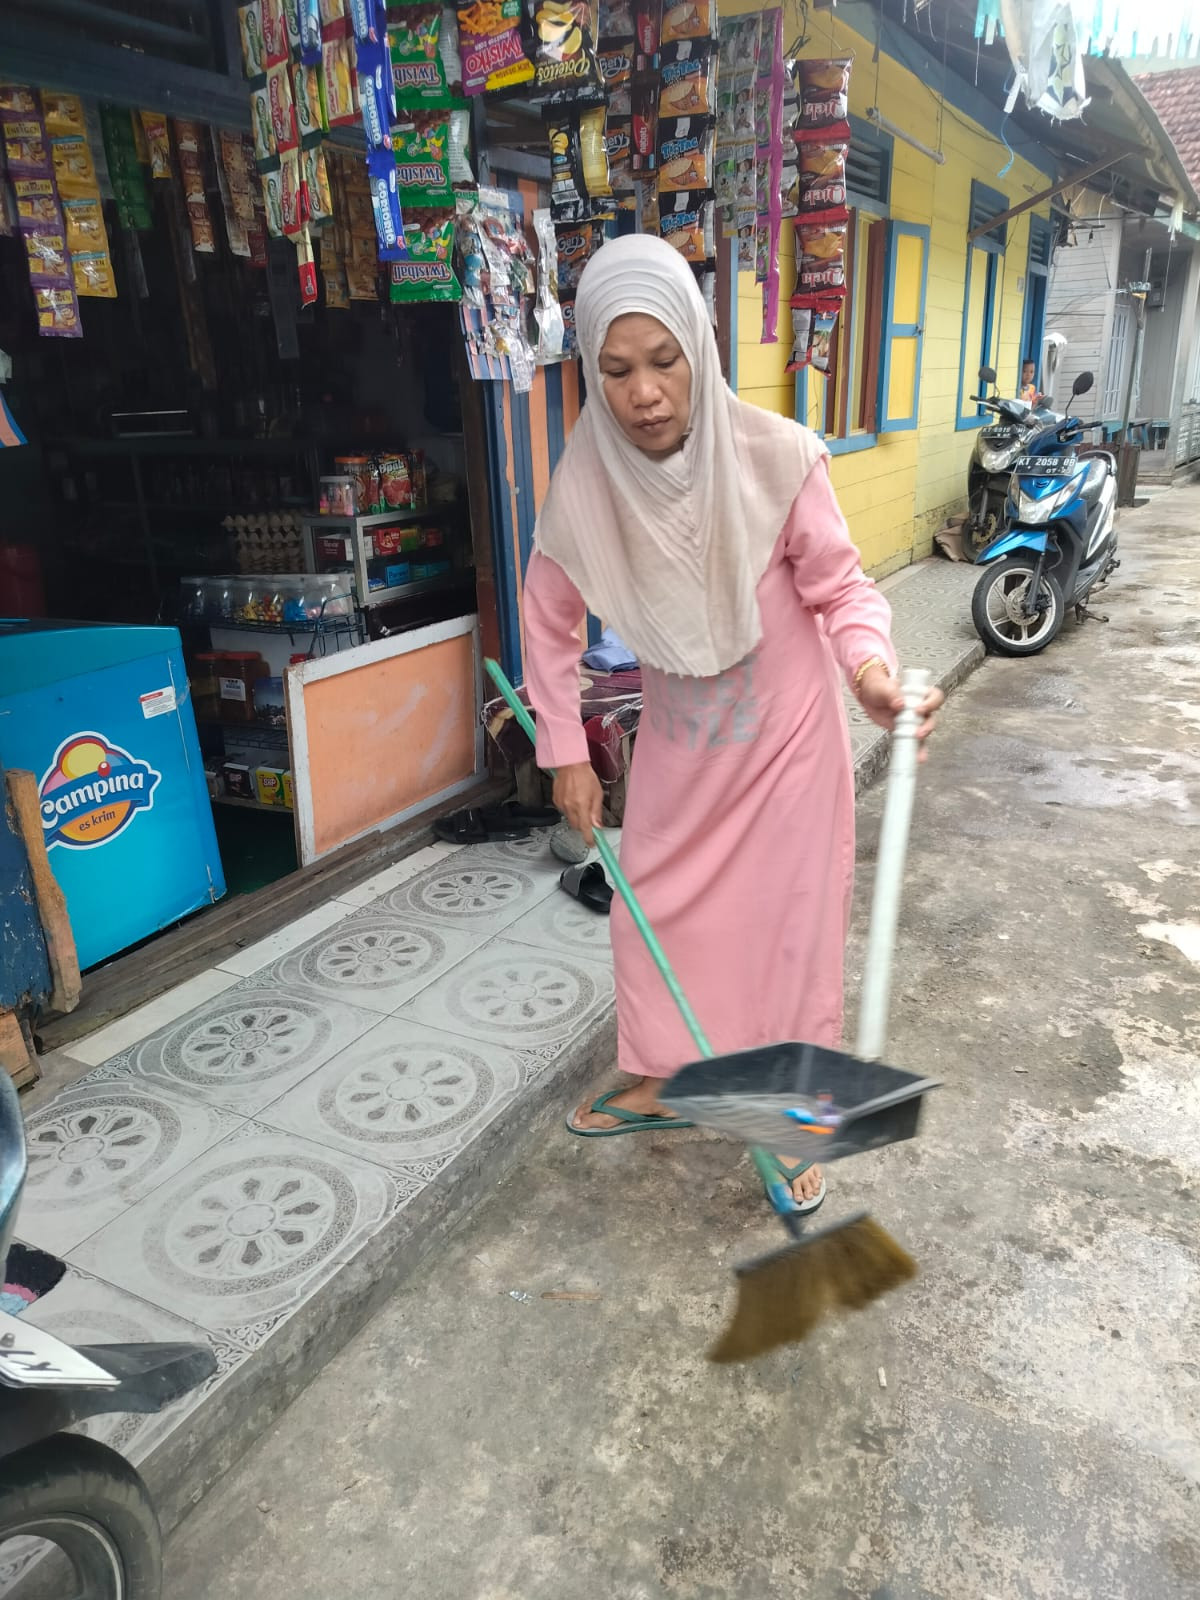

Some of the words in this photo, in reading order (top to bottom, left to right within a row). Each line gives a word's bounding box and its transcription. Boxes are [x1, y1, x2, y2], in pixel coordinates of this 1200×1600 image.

[393, 66, 437, 84] Twistb
[396, 166, 443, 184] Twistba
[804, 184, 845, 206] Qtela
[393, 263, 449, 281] Twistball
[1018, 457, 1031, 466] KT
[1035, 457, 1058, 466] 2058
[40, 769, 144, 829] Campina
[78, 820, 91, 832] es
[91, 809, 116, 827] krim
